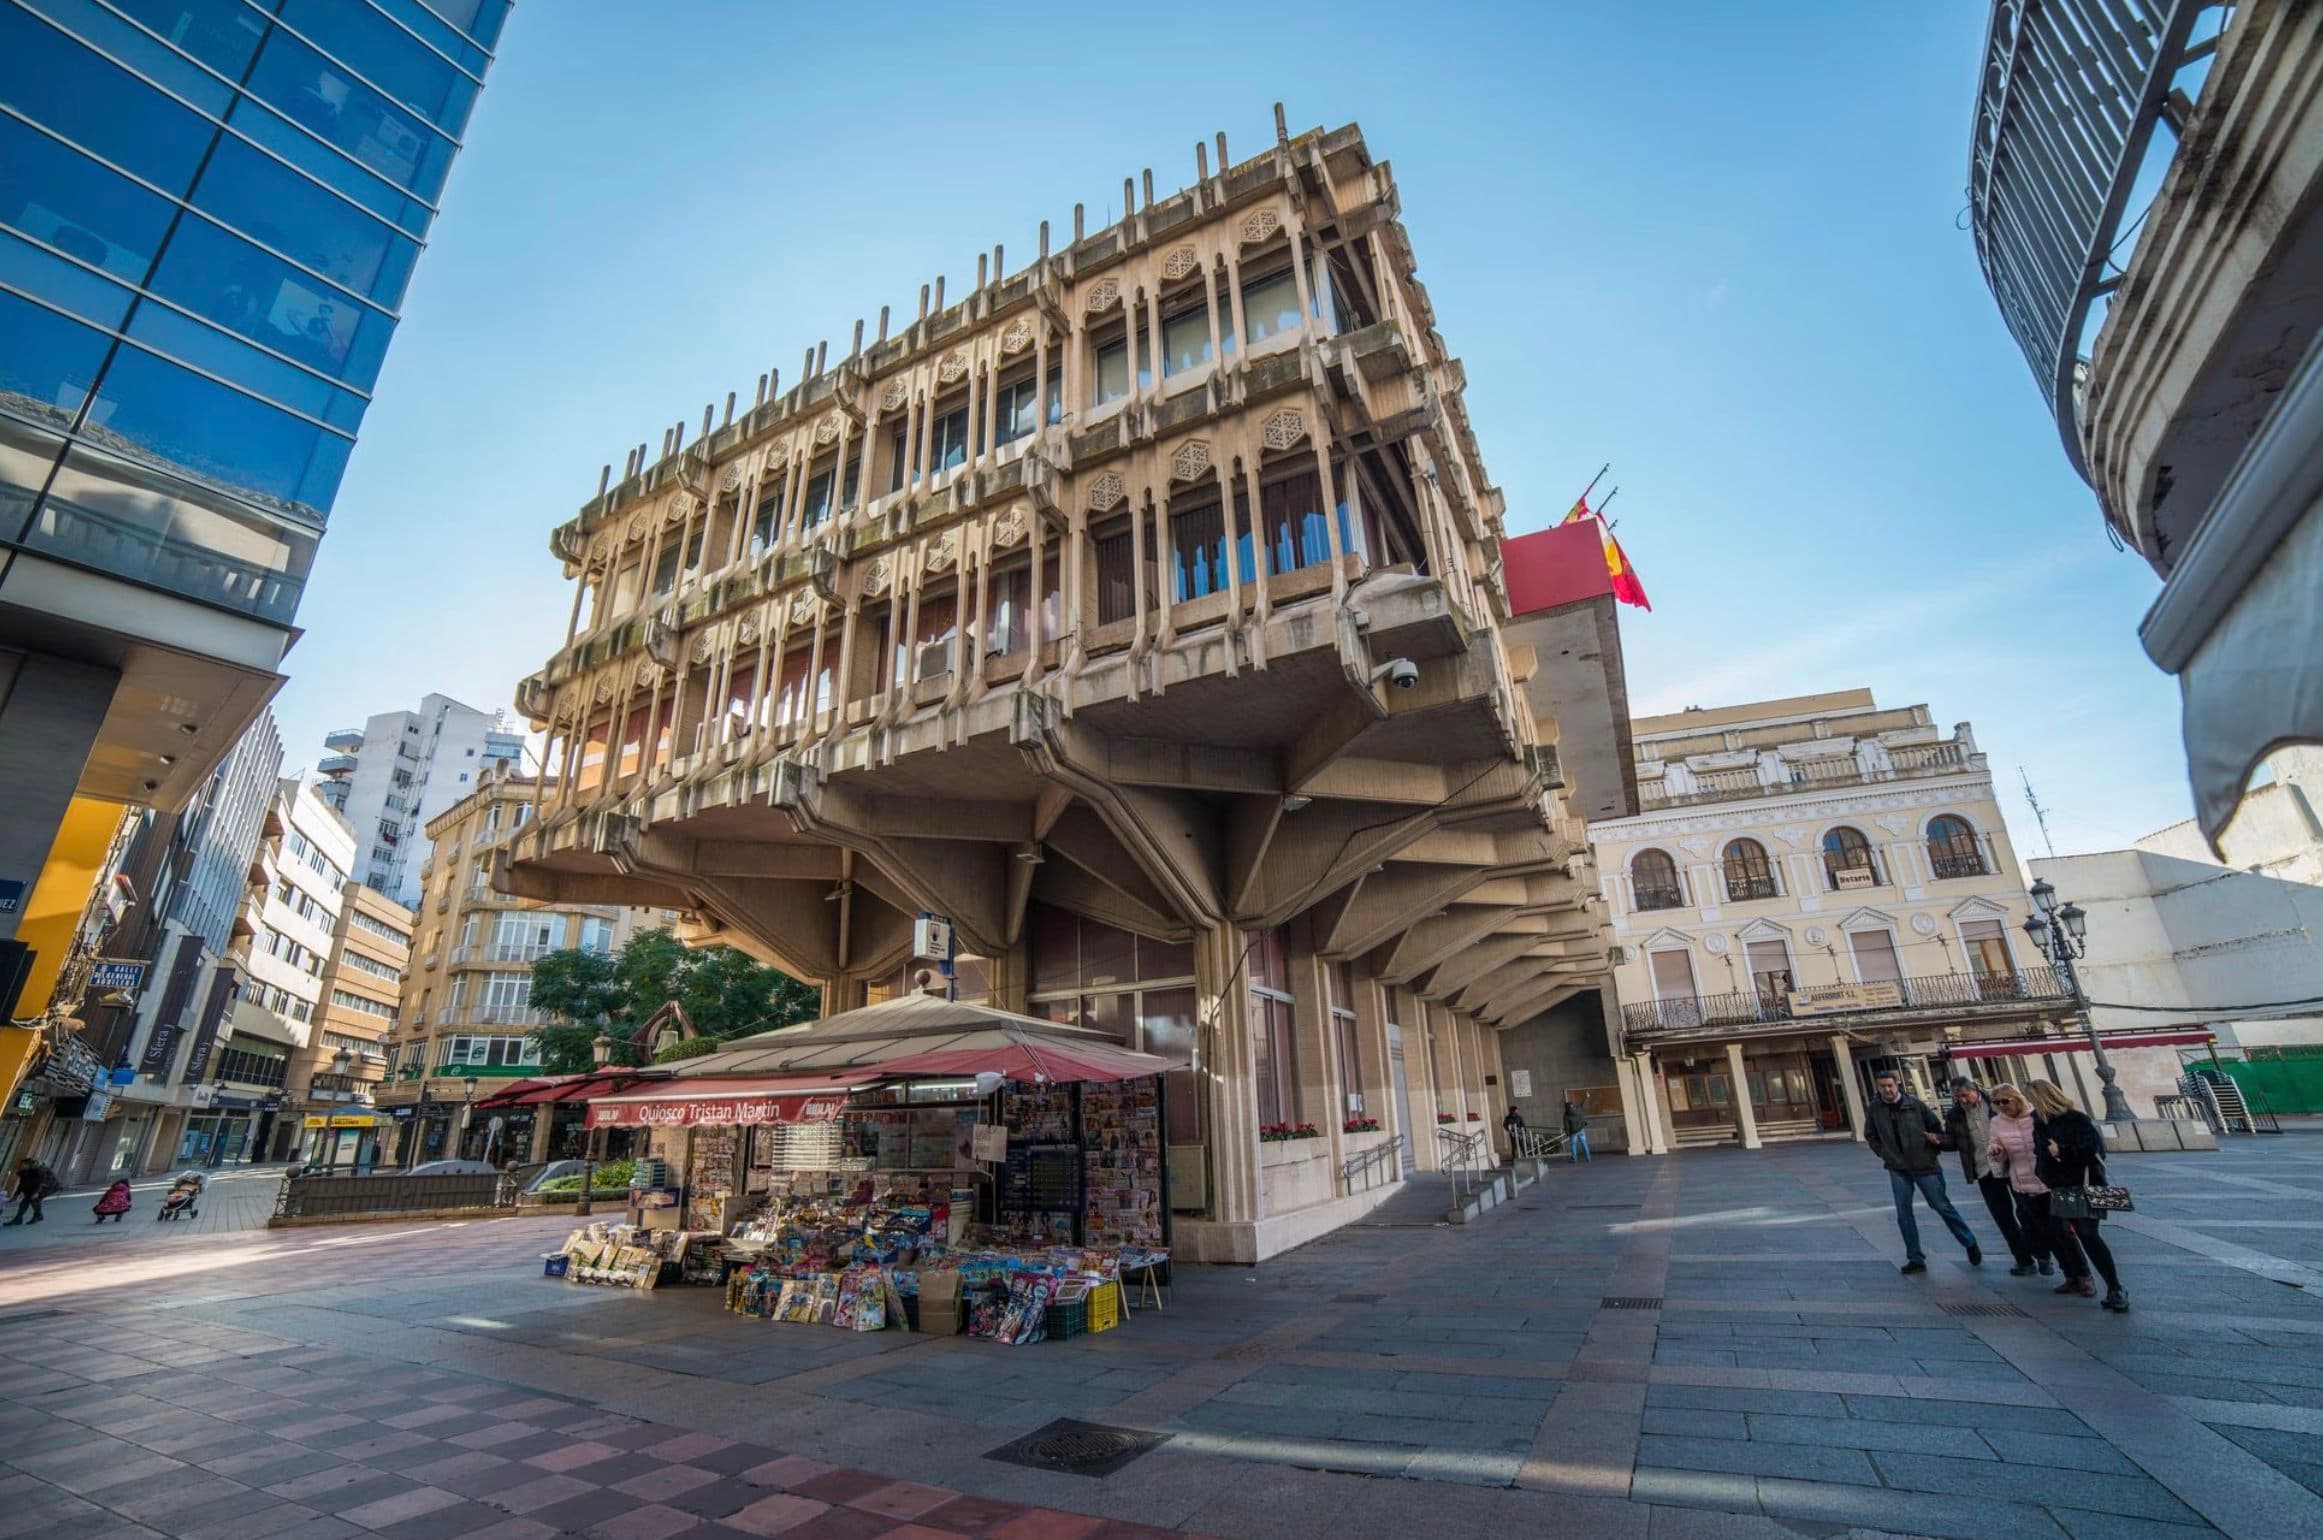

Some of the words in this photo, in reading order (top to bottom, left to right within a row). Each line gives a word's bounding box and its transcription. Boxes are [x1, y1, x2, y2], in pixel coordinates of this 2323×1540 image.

[114, 965, 139, 974] CALLE
[639, 1104, 685, 1121] Quiosco
[689, 1103, 732, 1120] Tristan
